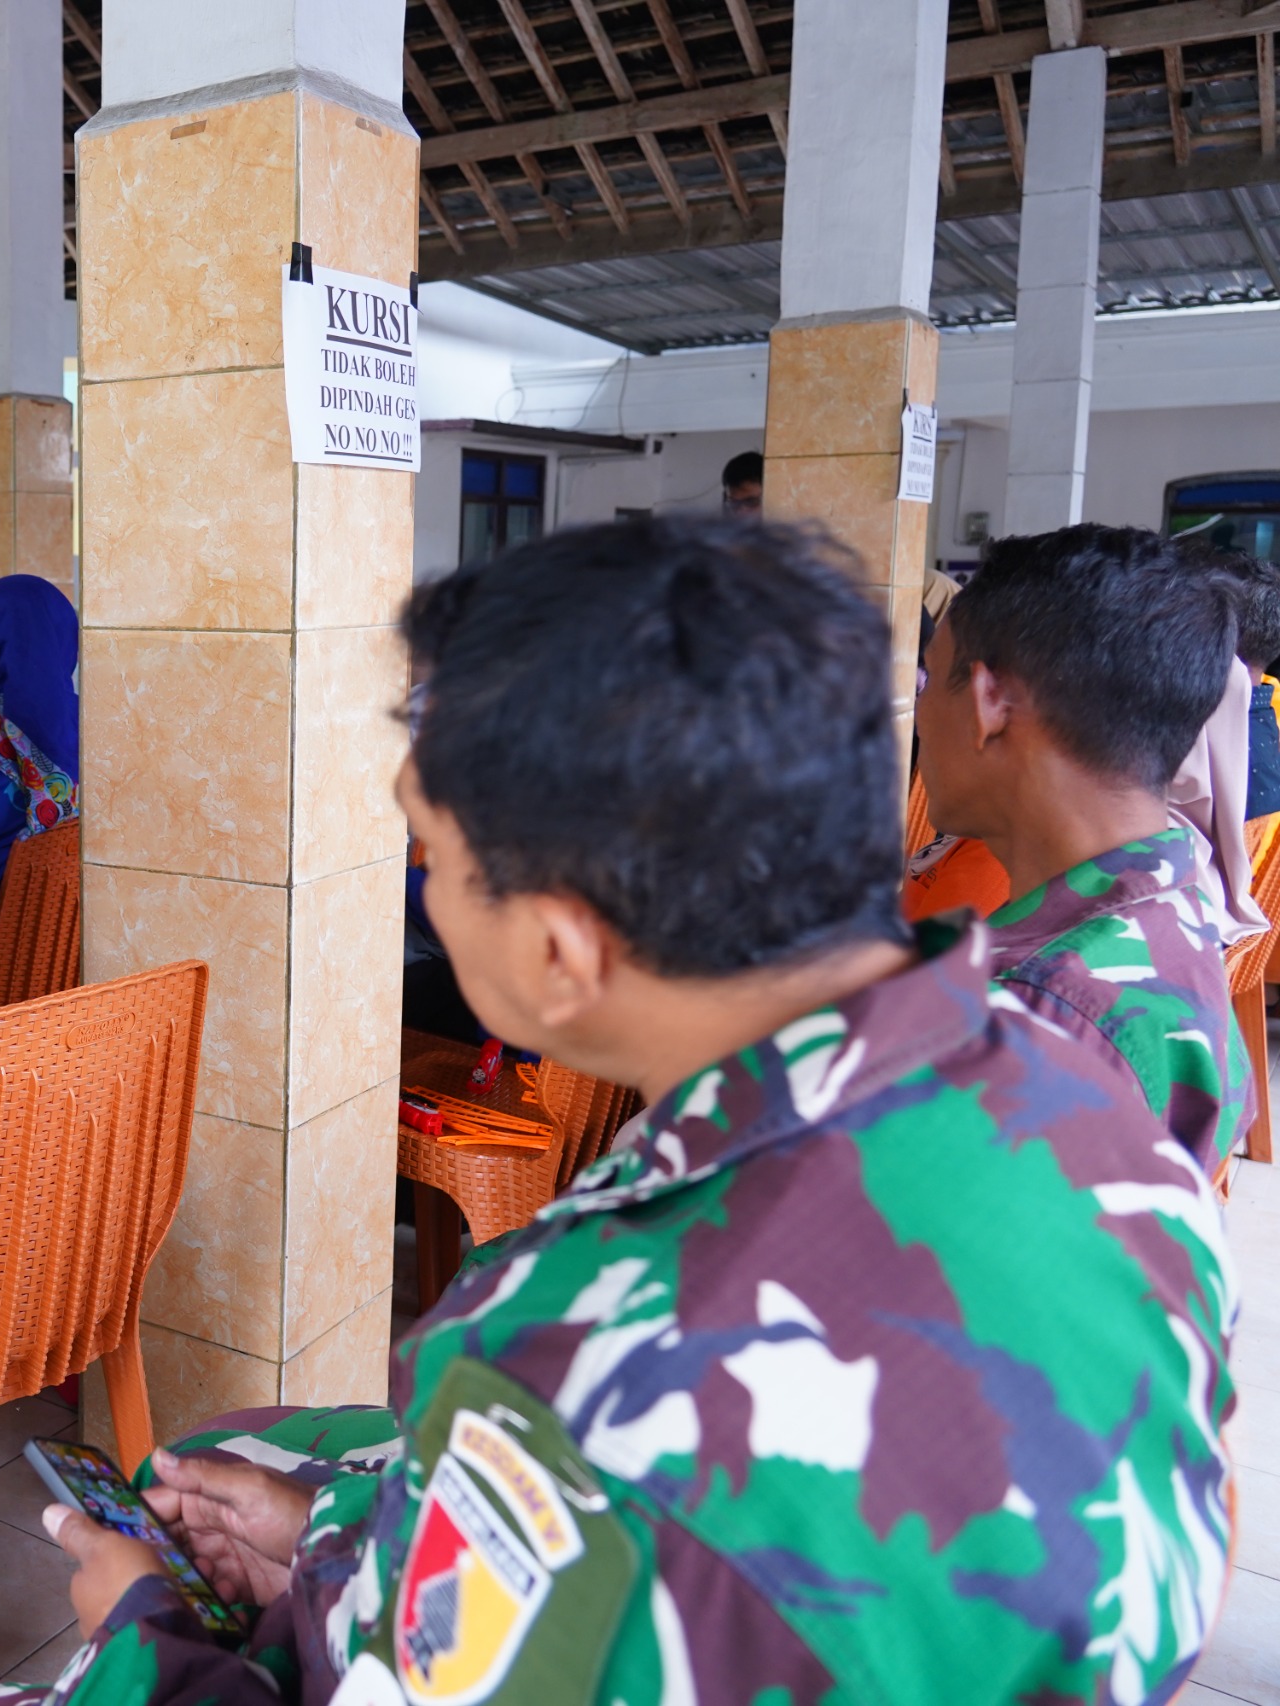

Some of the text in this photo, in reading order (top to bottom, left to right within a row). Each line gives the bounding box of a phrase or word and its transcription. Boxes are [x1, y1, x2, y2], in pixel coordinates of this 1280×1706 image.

[325, 285, 411, 345] KURSI
[321, 349, 416, 387] TIDAK BOLEH
[320, 385, 416, 421] DIPINDAH GES
[324, 424, 350, 449] NO
[355, 427, 377, 452] NO
[381, 430, 400, 455] NO
